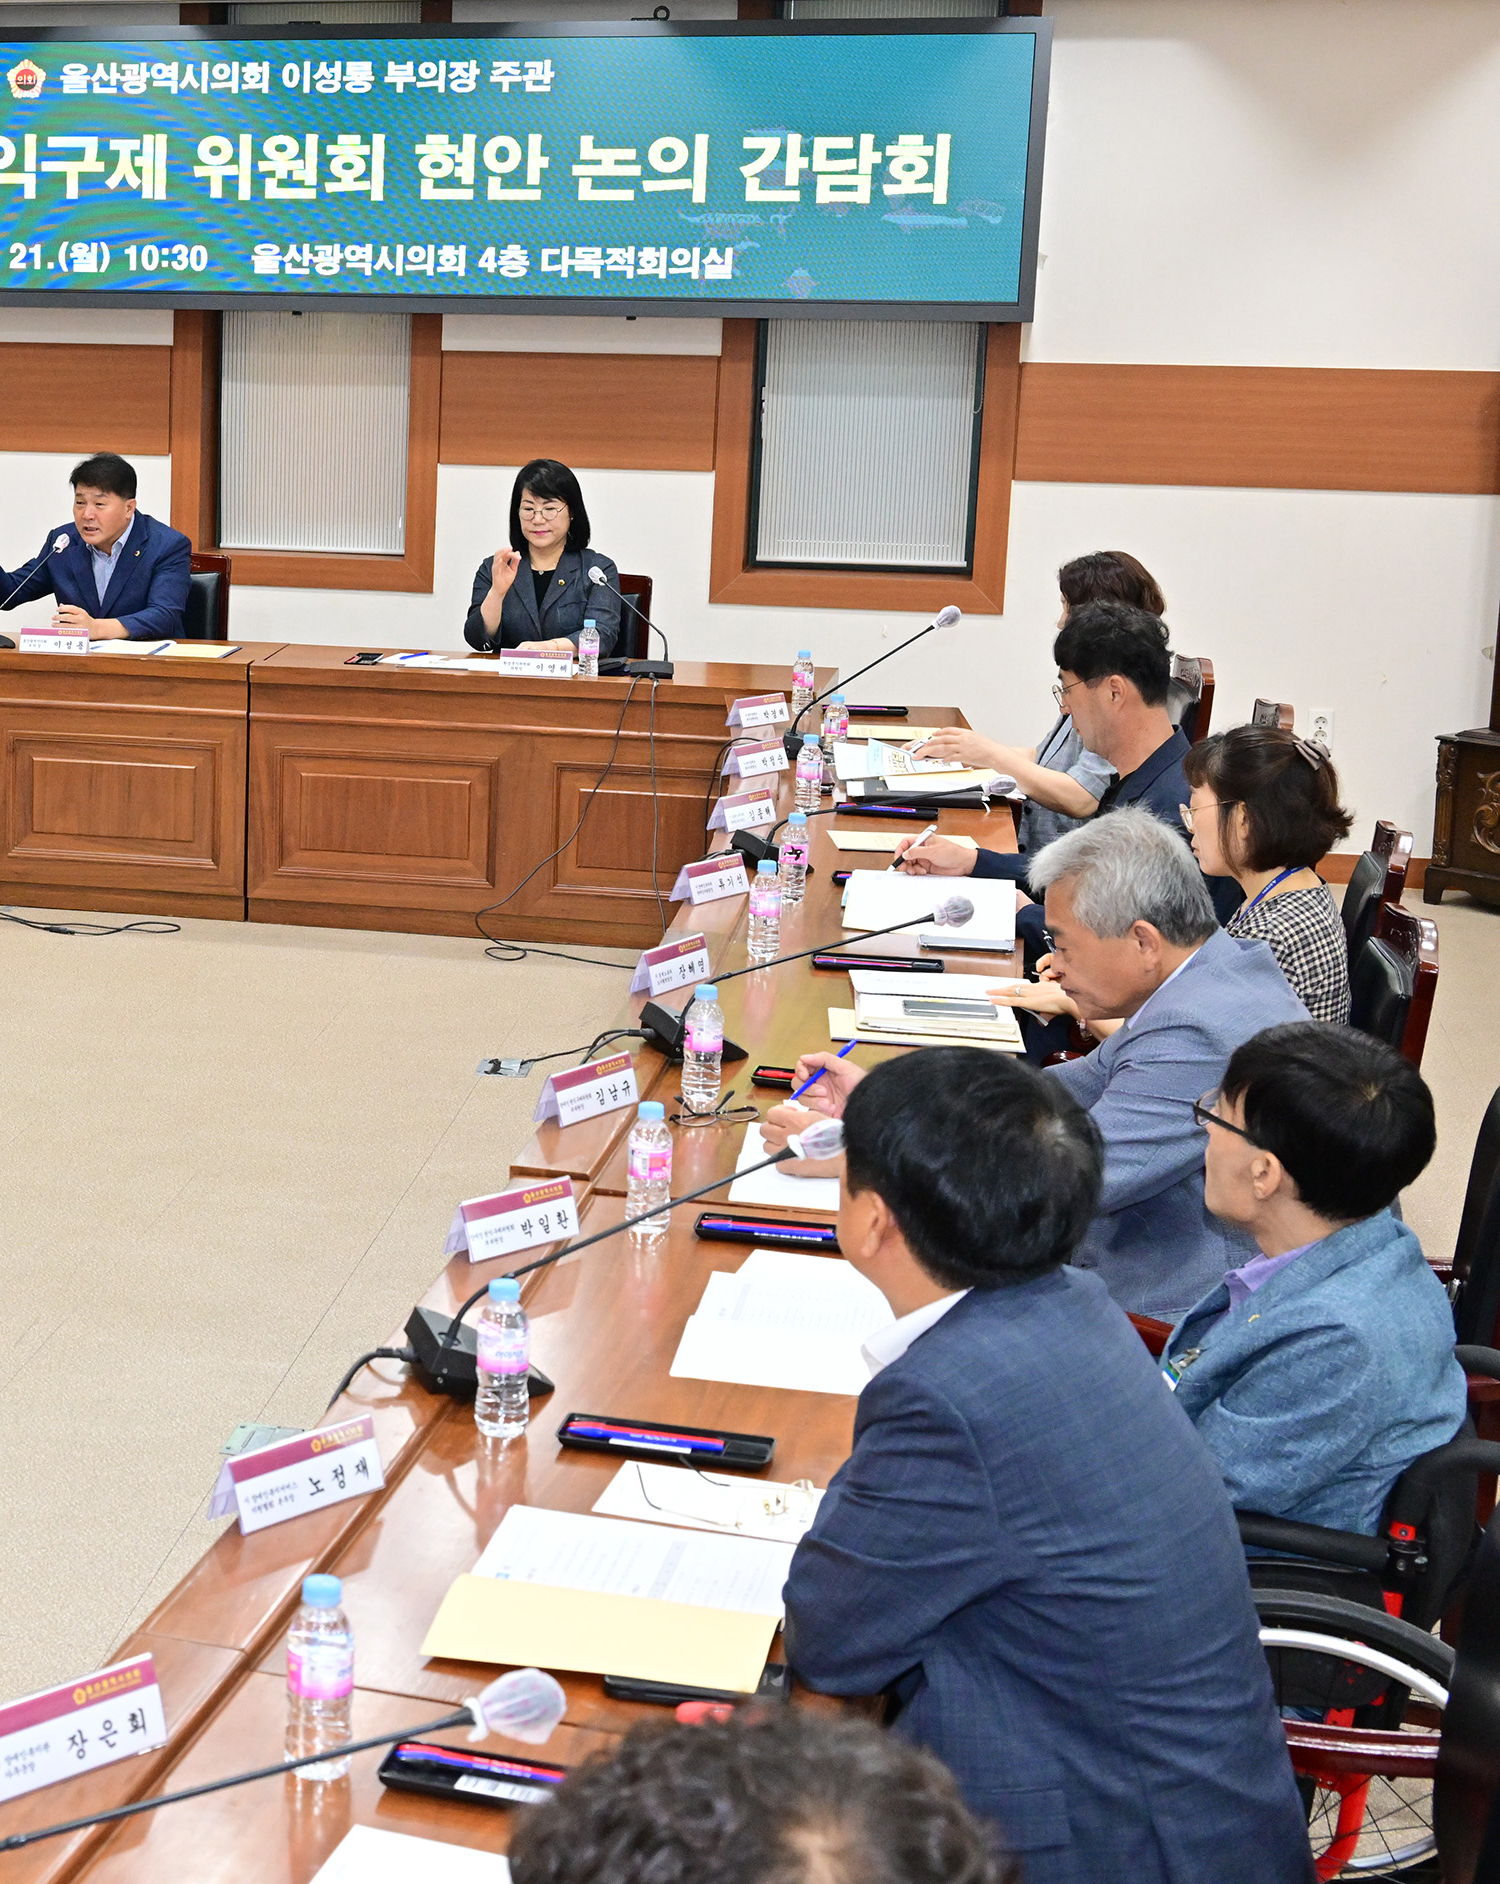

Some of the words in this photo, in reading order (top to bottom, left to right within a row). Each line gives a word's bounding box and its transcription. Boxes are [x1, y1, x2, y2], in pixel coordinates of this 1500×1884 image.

[60, 61, 270, 95] 울산광역시의회
[282, 60, 375, 94] 이성룡
[384, 60, 481, 93] 부의장
[489, 60, 555, 93] 주관
[193, 133, 386, 201] 위원회
[414, 133, 550, 201] 현안
[571, 133, 710, 204] 논의
[739, 133, 952, 205] 간담회
[9, 241, 110, 273] 21.(월)
[124, 245, 208, 272] 10:30
[251, 243, 467, 277] 울산광역시의회
[478, 244, 530, 278] 4층
[540, 245, 734, 280] 다목적회의실
[596, 1080, 630, 1106] 김남규
[520, 1209, 570, 1238] 박일환
[308, 1456, 371, 1497] 노정재
